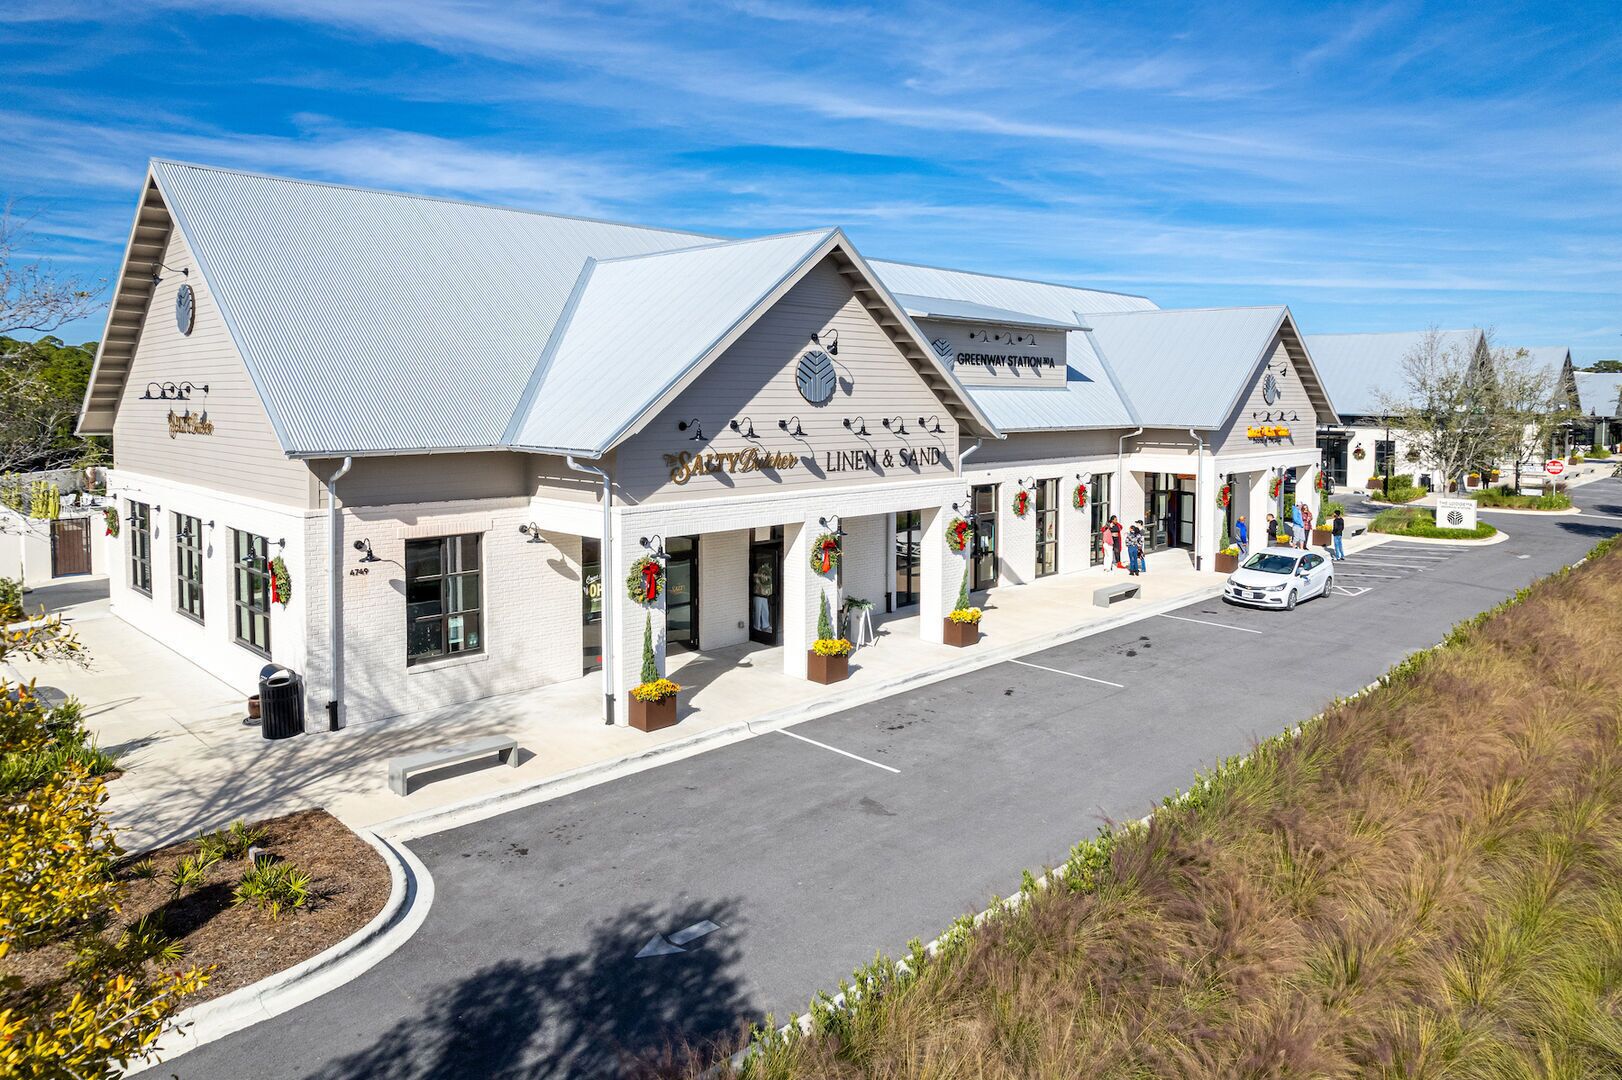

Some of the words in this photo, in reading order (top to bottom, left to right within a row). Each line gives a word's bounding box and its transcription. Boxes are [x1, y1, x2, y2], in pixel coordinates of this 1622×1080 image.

[957, 353, 1006, 367] GREENWAY
[1007, 355, 1042, 368] STATION
[671, 450, 740, 485] SALTY
[738, 446, 799, 474] Butcher
[826, 450, 877, 472] LINEN
[882, 449, 894, 468] &
[899, 447, 940, 467] SAND
[349, 567, 370, 576] 4749
